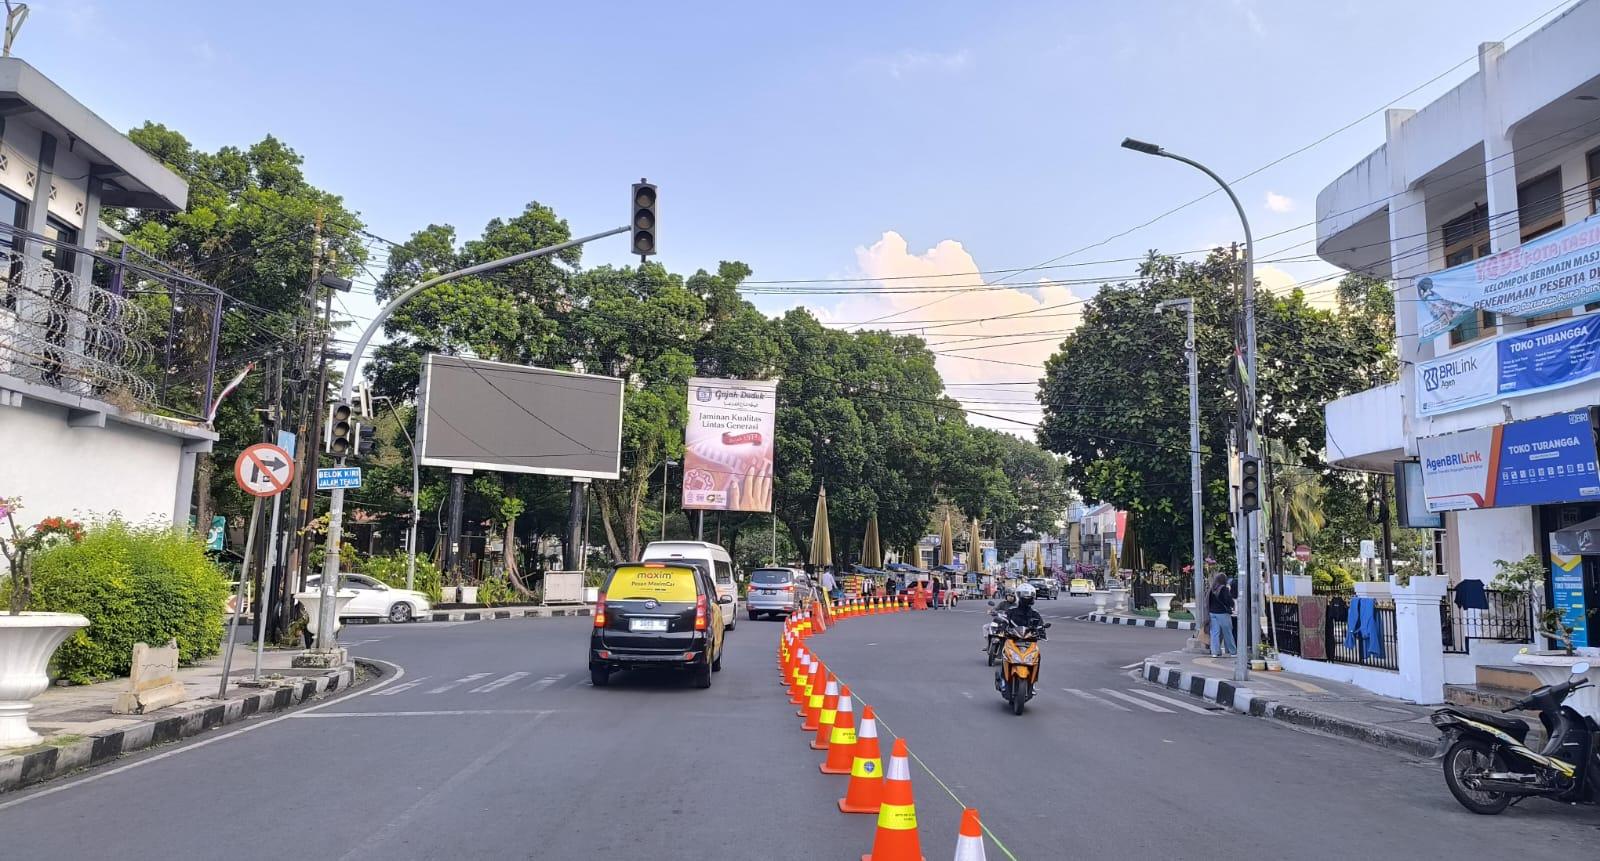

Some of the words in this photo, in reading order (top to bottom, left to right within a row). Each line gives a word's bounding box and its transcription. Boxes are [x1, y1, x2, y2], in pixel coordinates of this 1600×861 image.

[1484, 274, 1528, 294] KELOMPOK
[1530, 260, 1572, 280] BERMAIN
[1473, 286, 1537, 310] PENERIMAAN
[1539, 272, 1586, 293] PESERTA
[1510, 340, 1534, 353] TOKO
[1535, 326, 1588, 347] TURANGGA
[1439, 356, 1478, 380] BRILink
[1440, 379, 1456, 390] Agen
[715, 389, 738, 400] Gajah
[740, 390, 766, 400] Duduk
[699, 412, 730, 421] Jaminan
[731, 413, 762, 422] Kualitas
[702, 421, 725, 429] Lintas
[726, 421, 759, 430] Generasi
[1507, 443, 1531, 455] TOKO
[1531, 436, 1580, 451] TURANGGA
[1426, 450, 1482, 470] AgenBRILink
